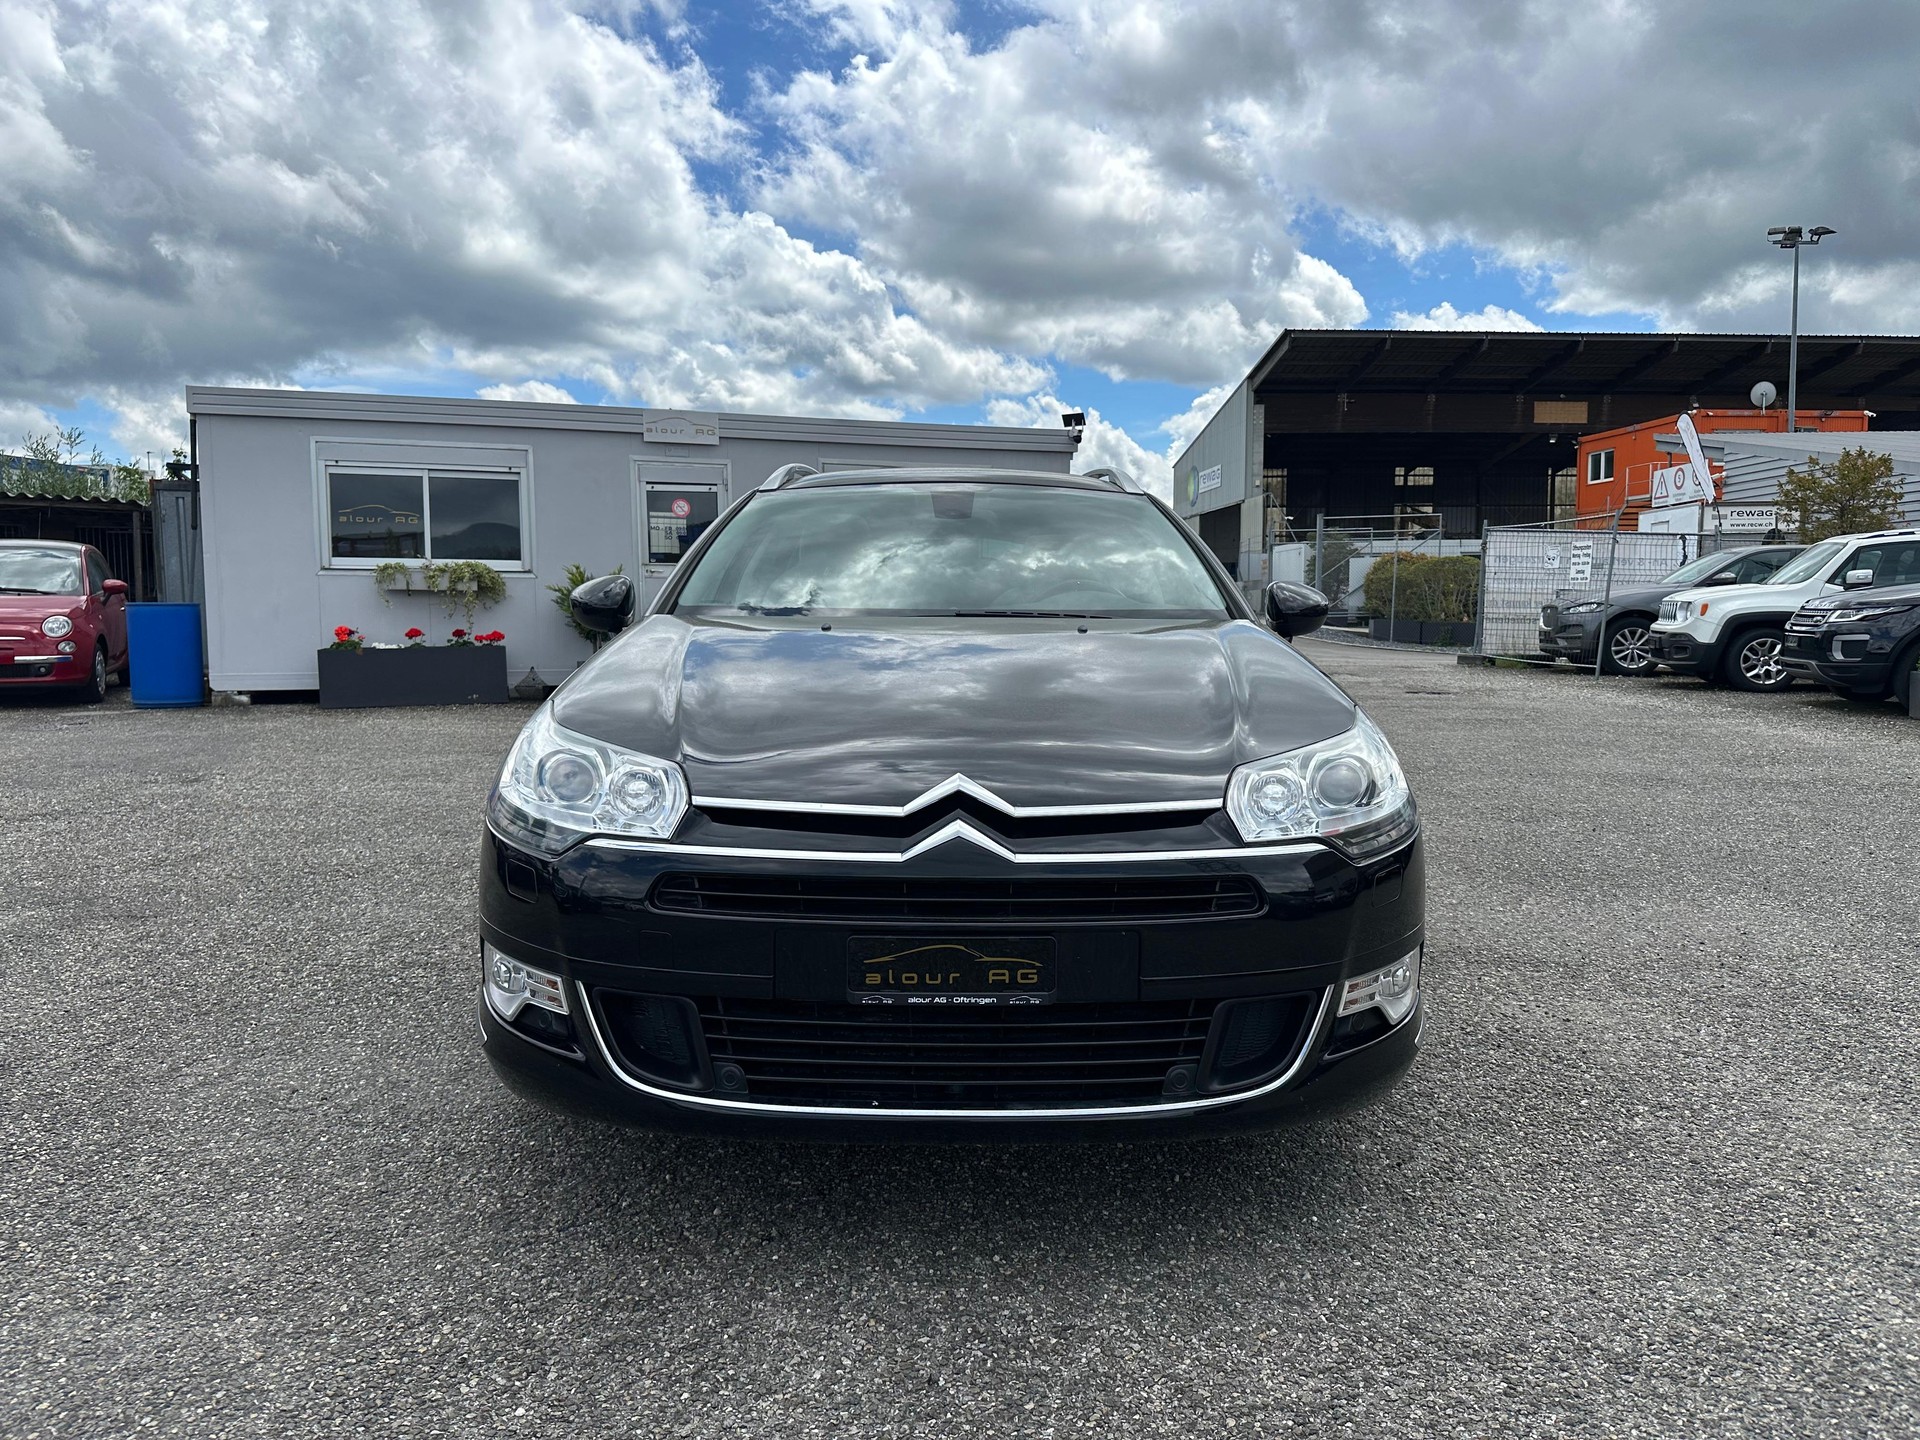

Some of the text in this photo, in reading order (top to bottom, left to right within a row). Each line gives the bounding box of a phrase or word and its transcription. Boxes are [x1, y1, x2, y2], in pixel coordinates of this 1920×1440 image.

[646, 426, 716, 436] alour AG
[338, 514, 419, 524] alour AG
[865, 969, 1039, 984] alour AG
[953, 996, 997, 1005] Oftringen
